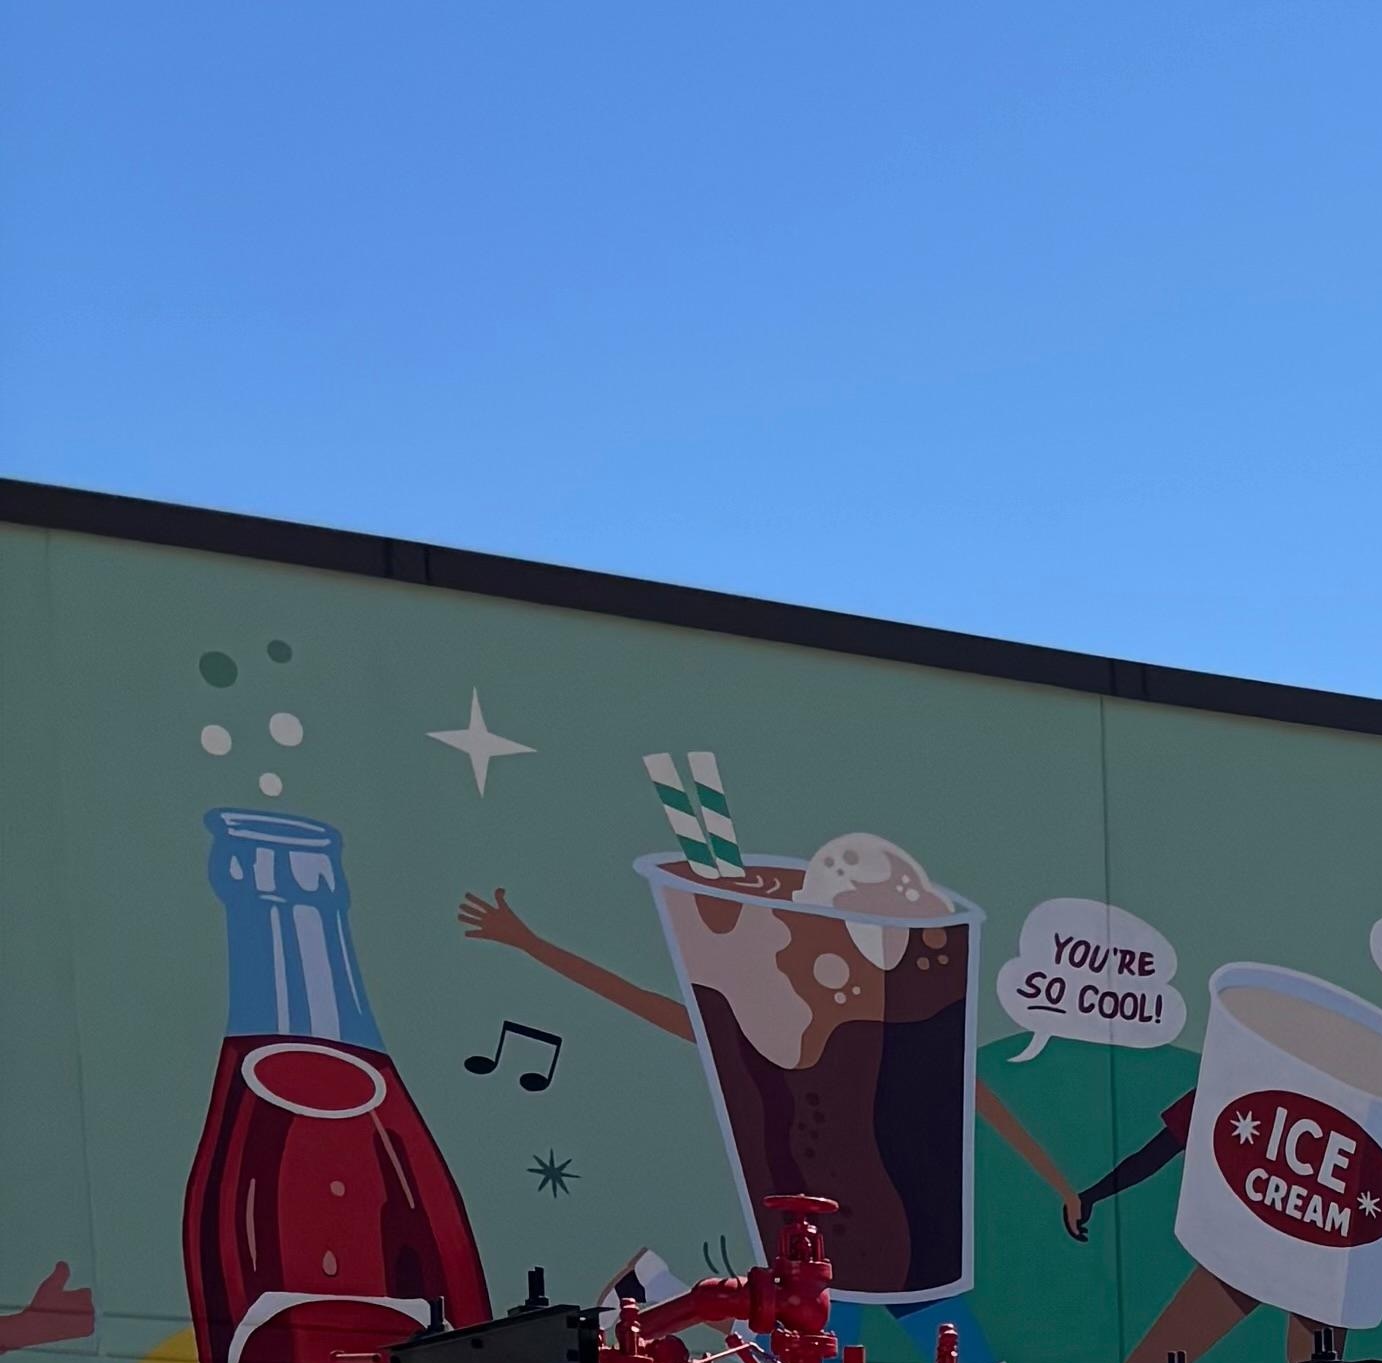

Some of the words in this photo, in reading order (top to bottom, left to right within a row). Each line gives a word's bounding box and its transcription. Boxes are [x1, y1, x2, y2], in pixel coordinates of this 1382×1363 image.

[1053, 933, 1156, 977] YOU'RE
[1016, 971, 1067, 1006] SO
[1078, 985, 1163, 1024] COOL!
[1265, 1106, 1357, 1194] ICE
[1245, 1167, 1352, 1237] CREAM
